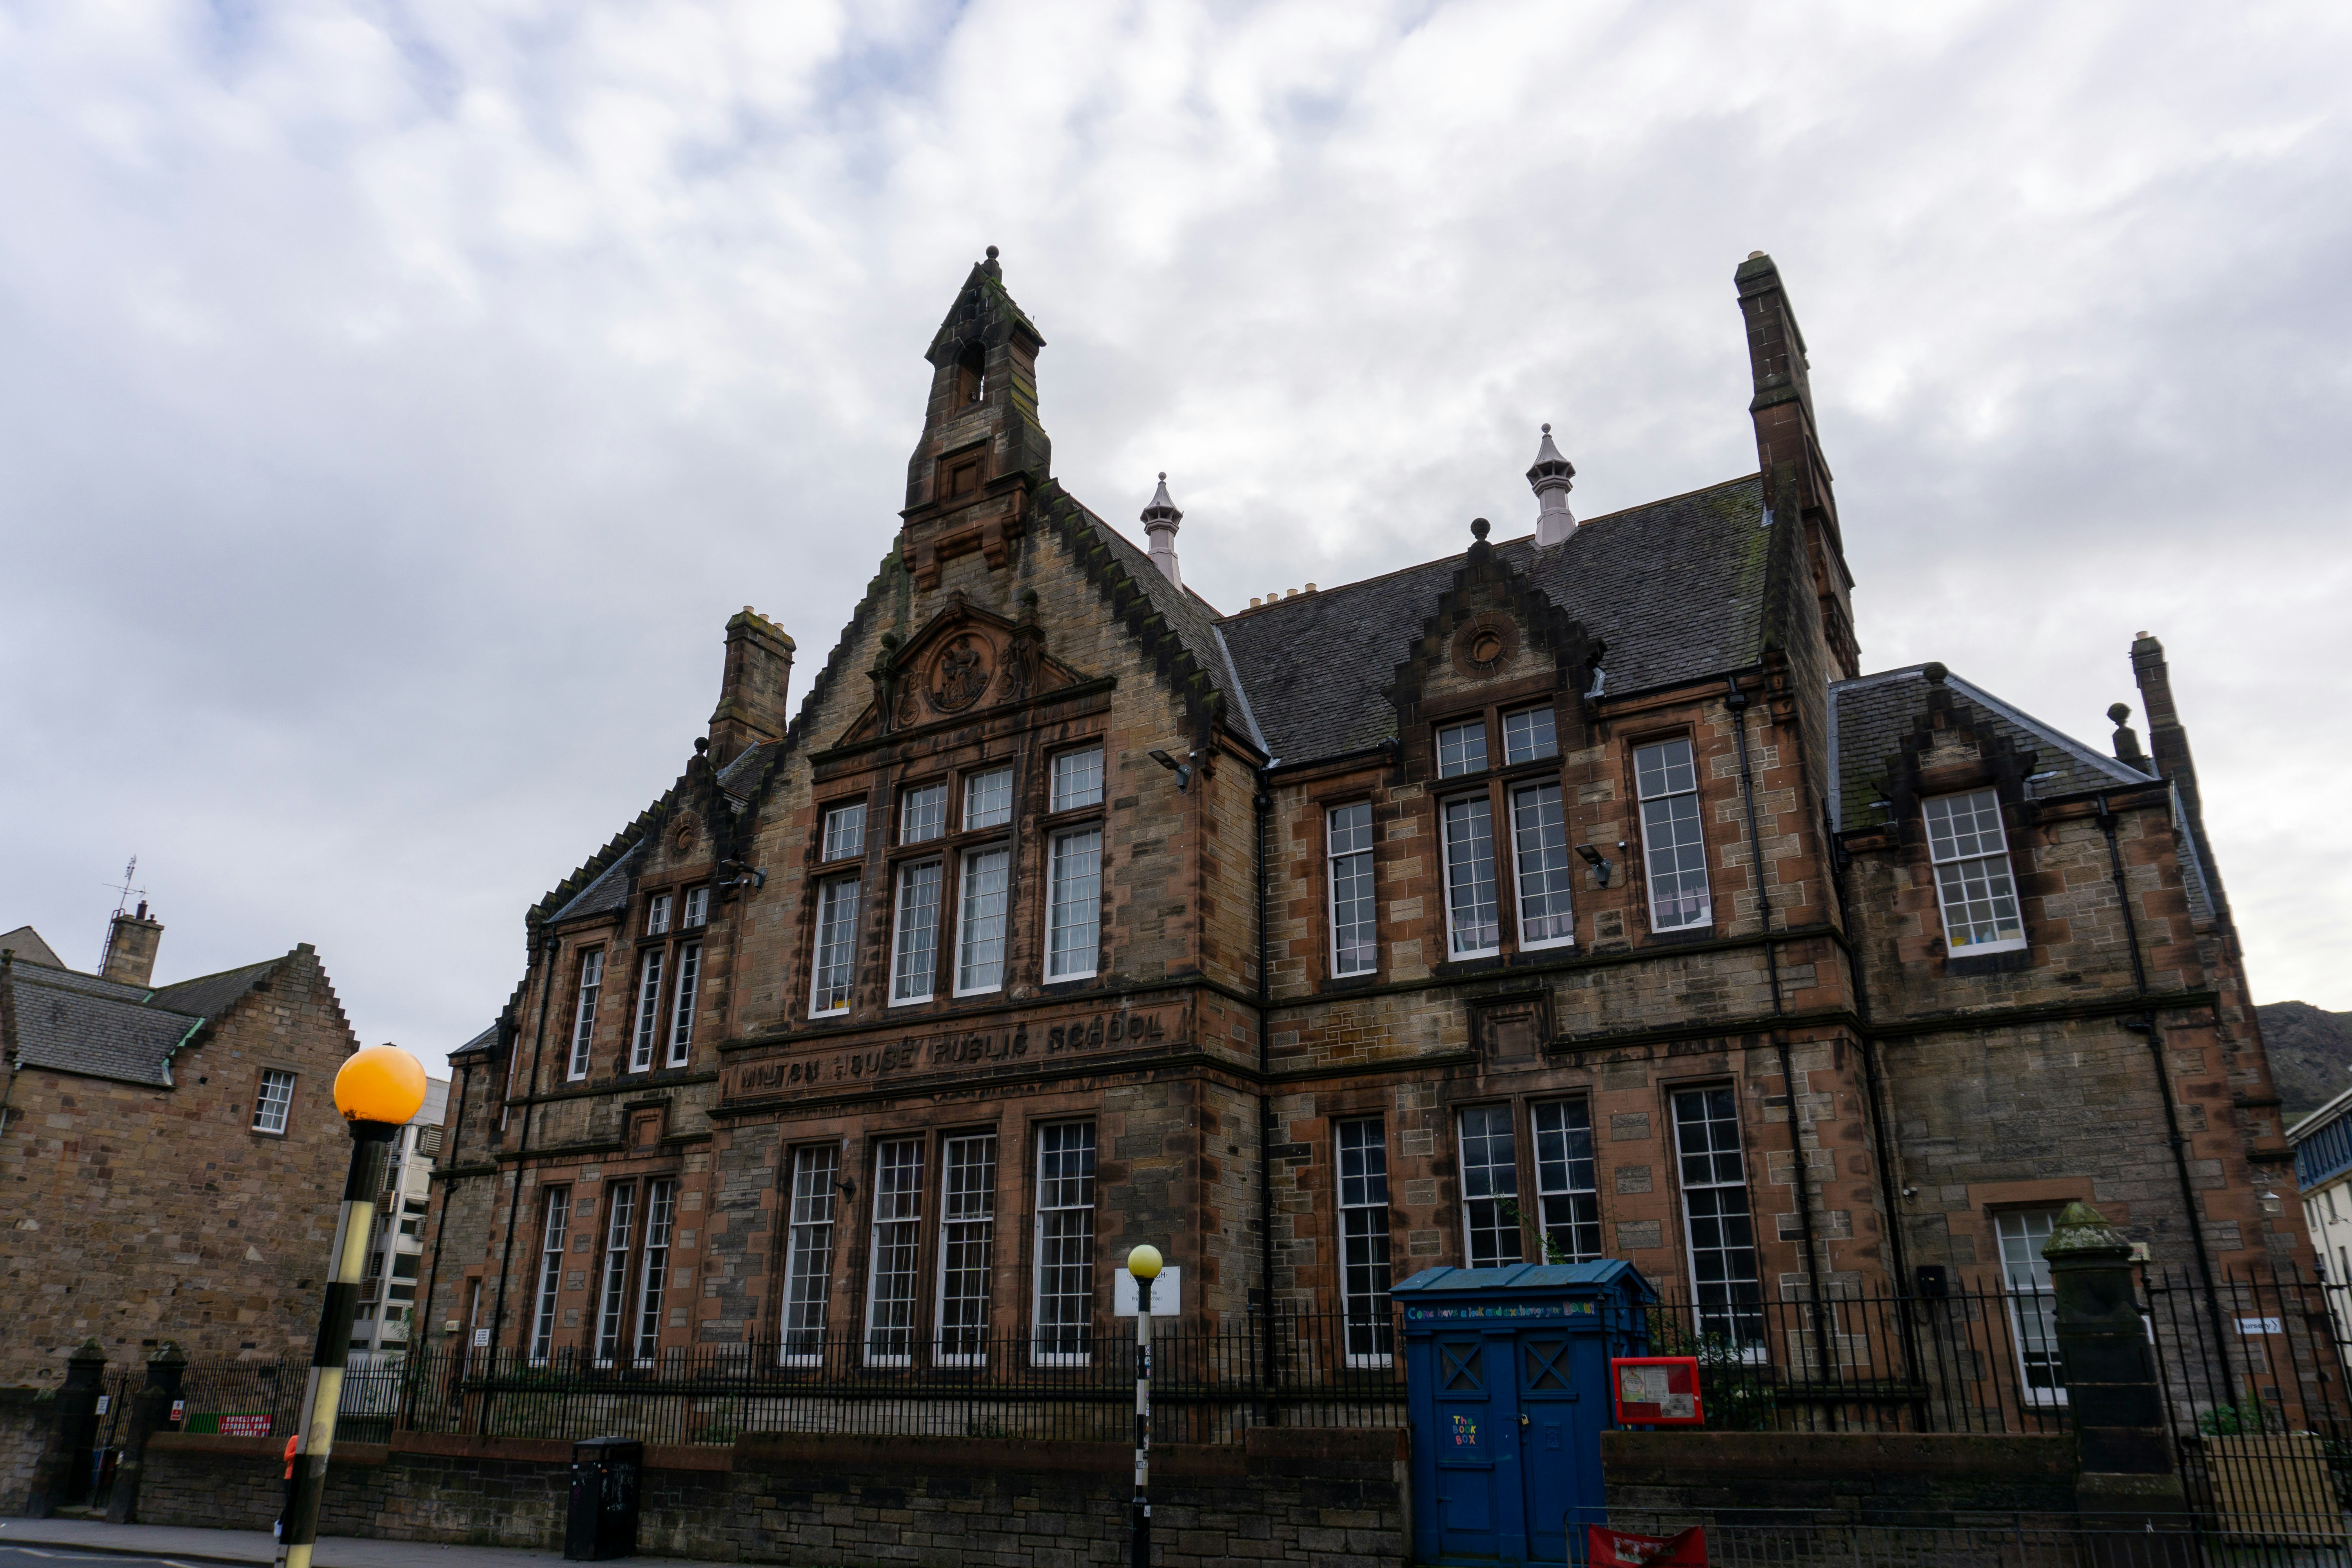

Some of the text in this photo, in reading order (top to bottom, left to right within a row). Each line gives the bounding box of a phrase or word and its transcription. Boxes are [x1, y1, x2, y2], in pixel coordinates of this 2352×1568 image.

[742, 1015, 1164, 1087] MILTON HOUSE PUBLIC SCHOOL
[1408, 1307, 1434, 1319] Come
[1437, 1307, 1459, 1318] have
[1486, 1306, 1502, 1316] and
[1503, 1305, 1545, 1318] exchange
[1545, 1307, 1562, 1318] your
[1453, 1416, 1474, 1425] The
[1452, 1425, 1476, 1434] BOOK
[1455, 1435, 1476, 1445] BOX
